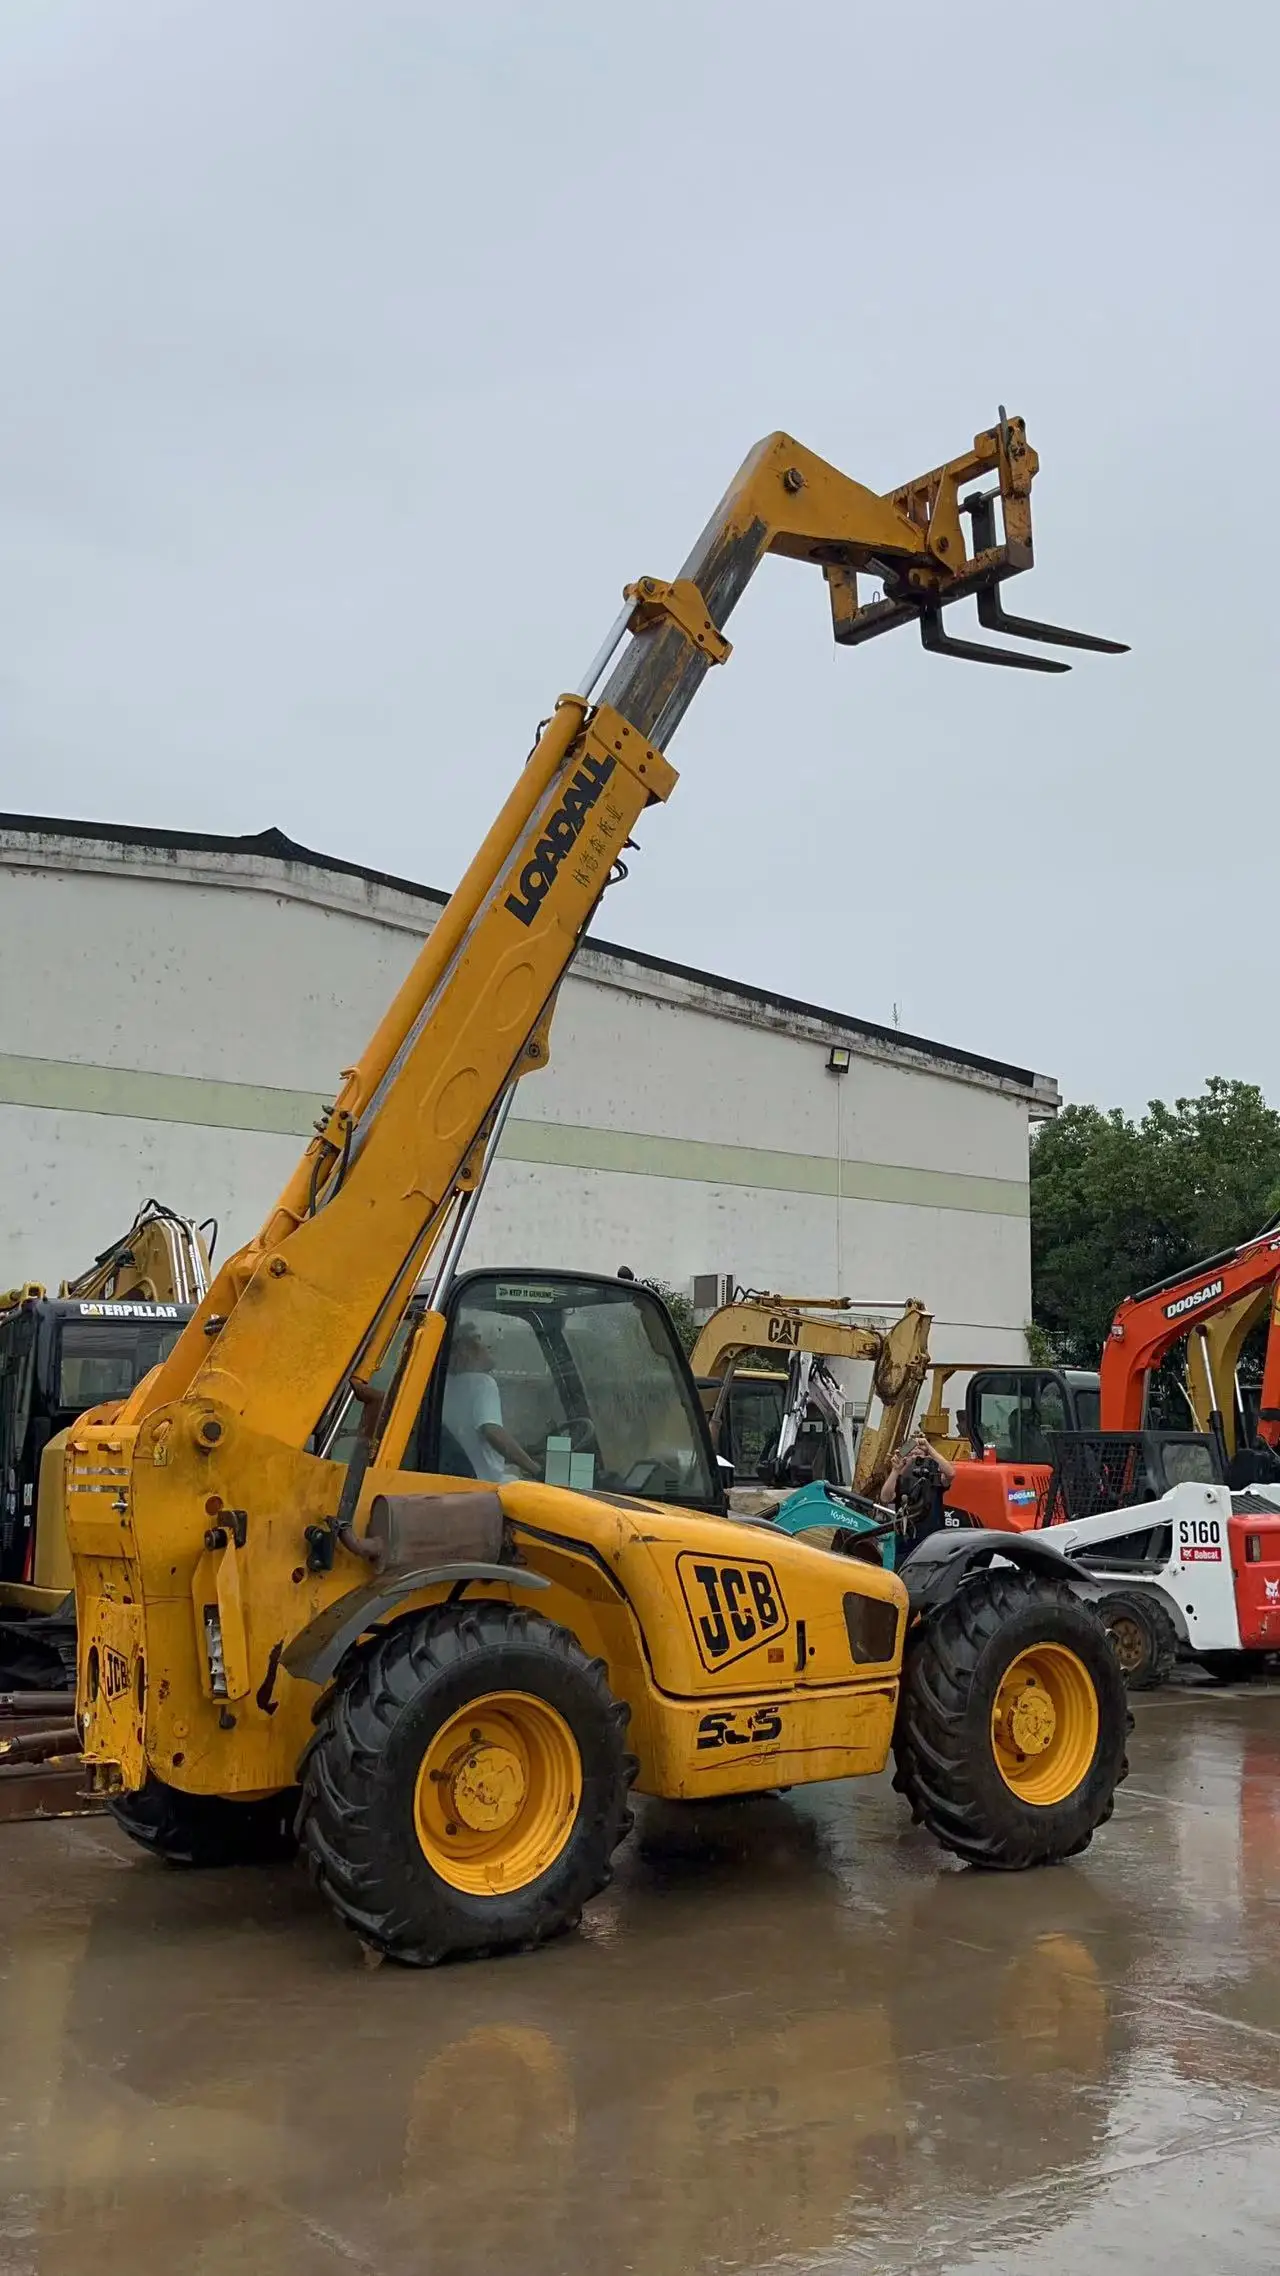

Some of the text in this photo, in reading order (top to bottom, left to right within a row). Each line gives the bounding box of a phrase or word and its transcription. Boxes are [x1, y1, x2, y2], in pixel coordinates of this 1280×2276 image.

[504, 752, 617, 927] LOADALL
[80, 1303, 177, 1318] CATERPILLAR
[1166, 1280, 1222, 1318] DOOSAN
[768, 1317, 802, 1347] CAT
[831, 1510, 858, 1528] Kubota
[1180, 1521, 1220, 1543] S160
[694, 1565, 779, 1657] JCB
[106, 1652, 129, 1697] JCB
